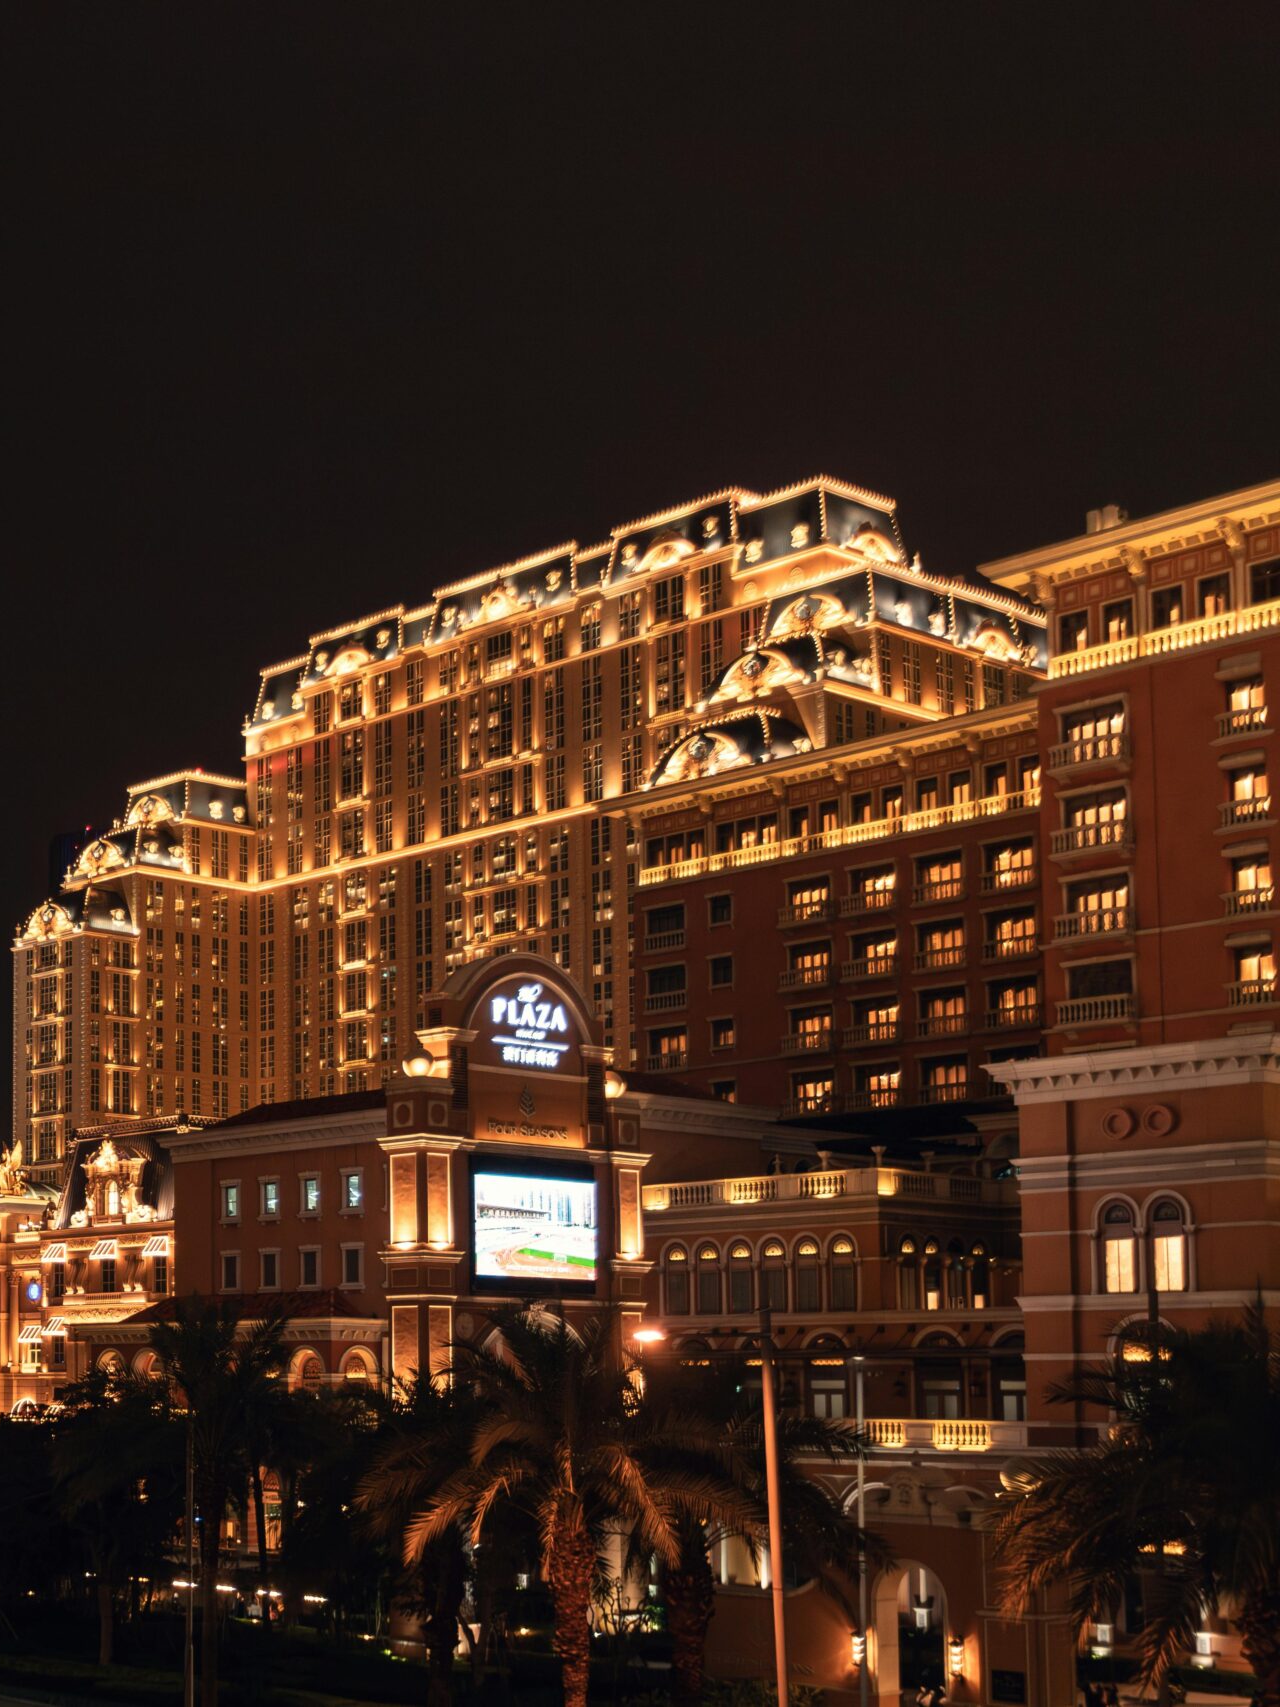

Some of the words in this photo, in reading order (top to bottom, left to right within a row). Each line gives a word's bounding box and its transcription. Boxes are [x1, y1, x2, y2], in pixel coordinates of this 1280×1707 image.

[492, 998, 567, 1031] PLAZA
[488, 1121, 517, 1136] FOUR
[520, 1125, 568, 1140] SEASONS
